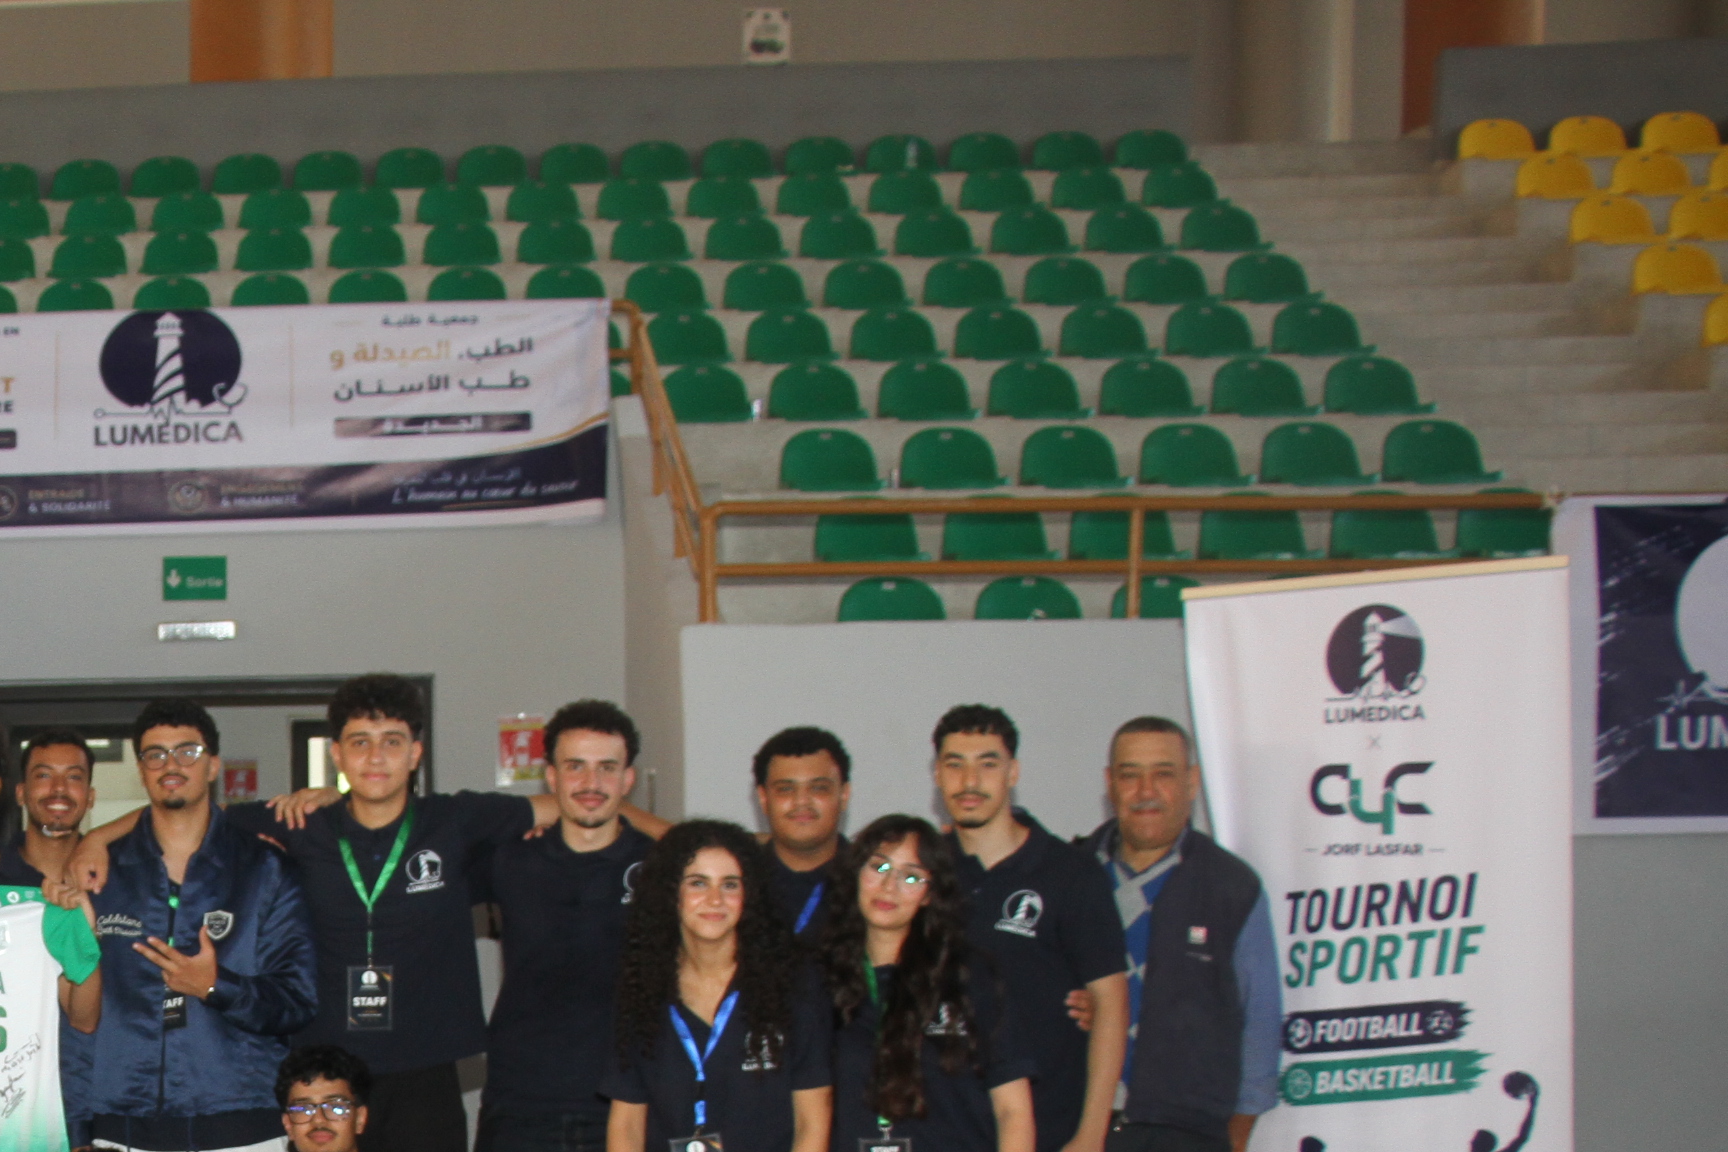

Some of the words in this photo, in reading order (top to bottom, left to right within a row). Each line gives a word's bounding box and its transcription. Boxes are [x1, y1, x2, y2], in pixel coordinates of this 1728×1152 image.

[3, 326, 20, 335] EN
[330, 348, 345, 370] و
[334, 373, 450, 402] الأسنان
[459, 369, 530, 397] طب
[94, 421, 243, 446] LUMEDICA
[1324, 704, 1426, 725] LUMEDICA
[1322, 842, 1361, 857] JORF
[1366, 841, 1424, 857] LASFAR
[1285, 872, 1478, 936] TOURNOI
[1285, 924, 1485, 989] SPORTIF
[162, 996, 184, 1009] AFF
[352, 995, 387, 1007] STAFF
[1315, 1011, 1423, 1043] FOOTBALL
[1315, 1060, 1457, 1095] BASKETBALL
